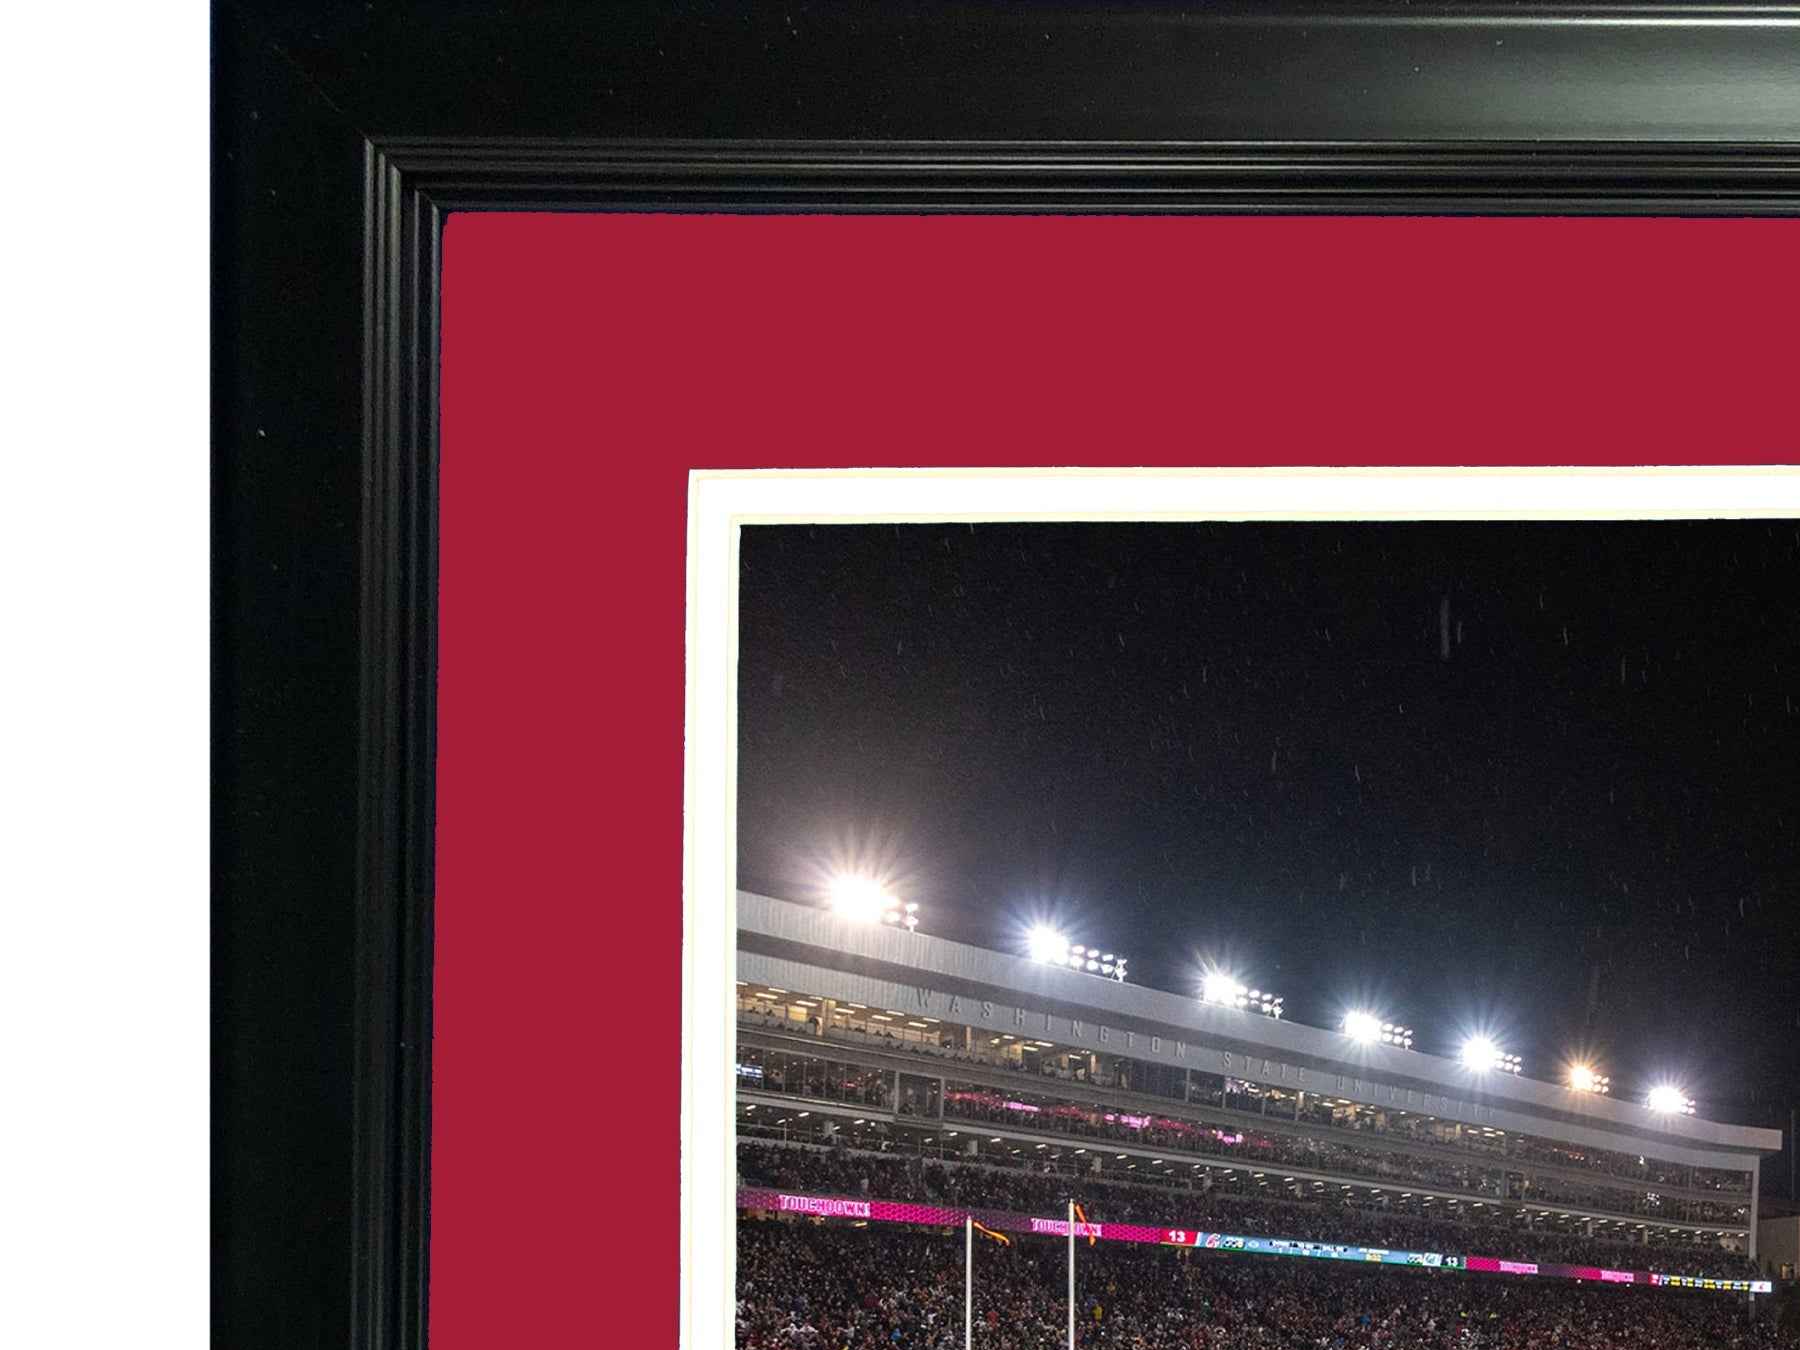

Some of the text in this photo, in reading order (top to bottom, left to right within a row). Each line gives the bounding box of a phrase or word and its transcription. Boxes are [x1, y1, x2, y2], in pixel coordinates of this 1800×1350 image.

[915, 986, 1188, 1058] WASHINGTON
[1222, 1051, 1305, 1082] STATE
[1168, 1230, 1186, 1242] 13
